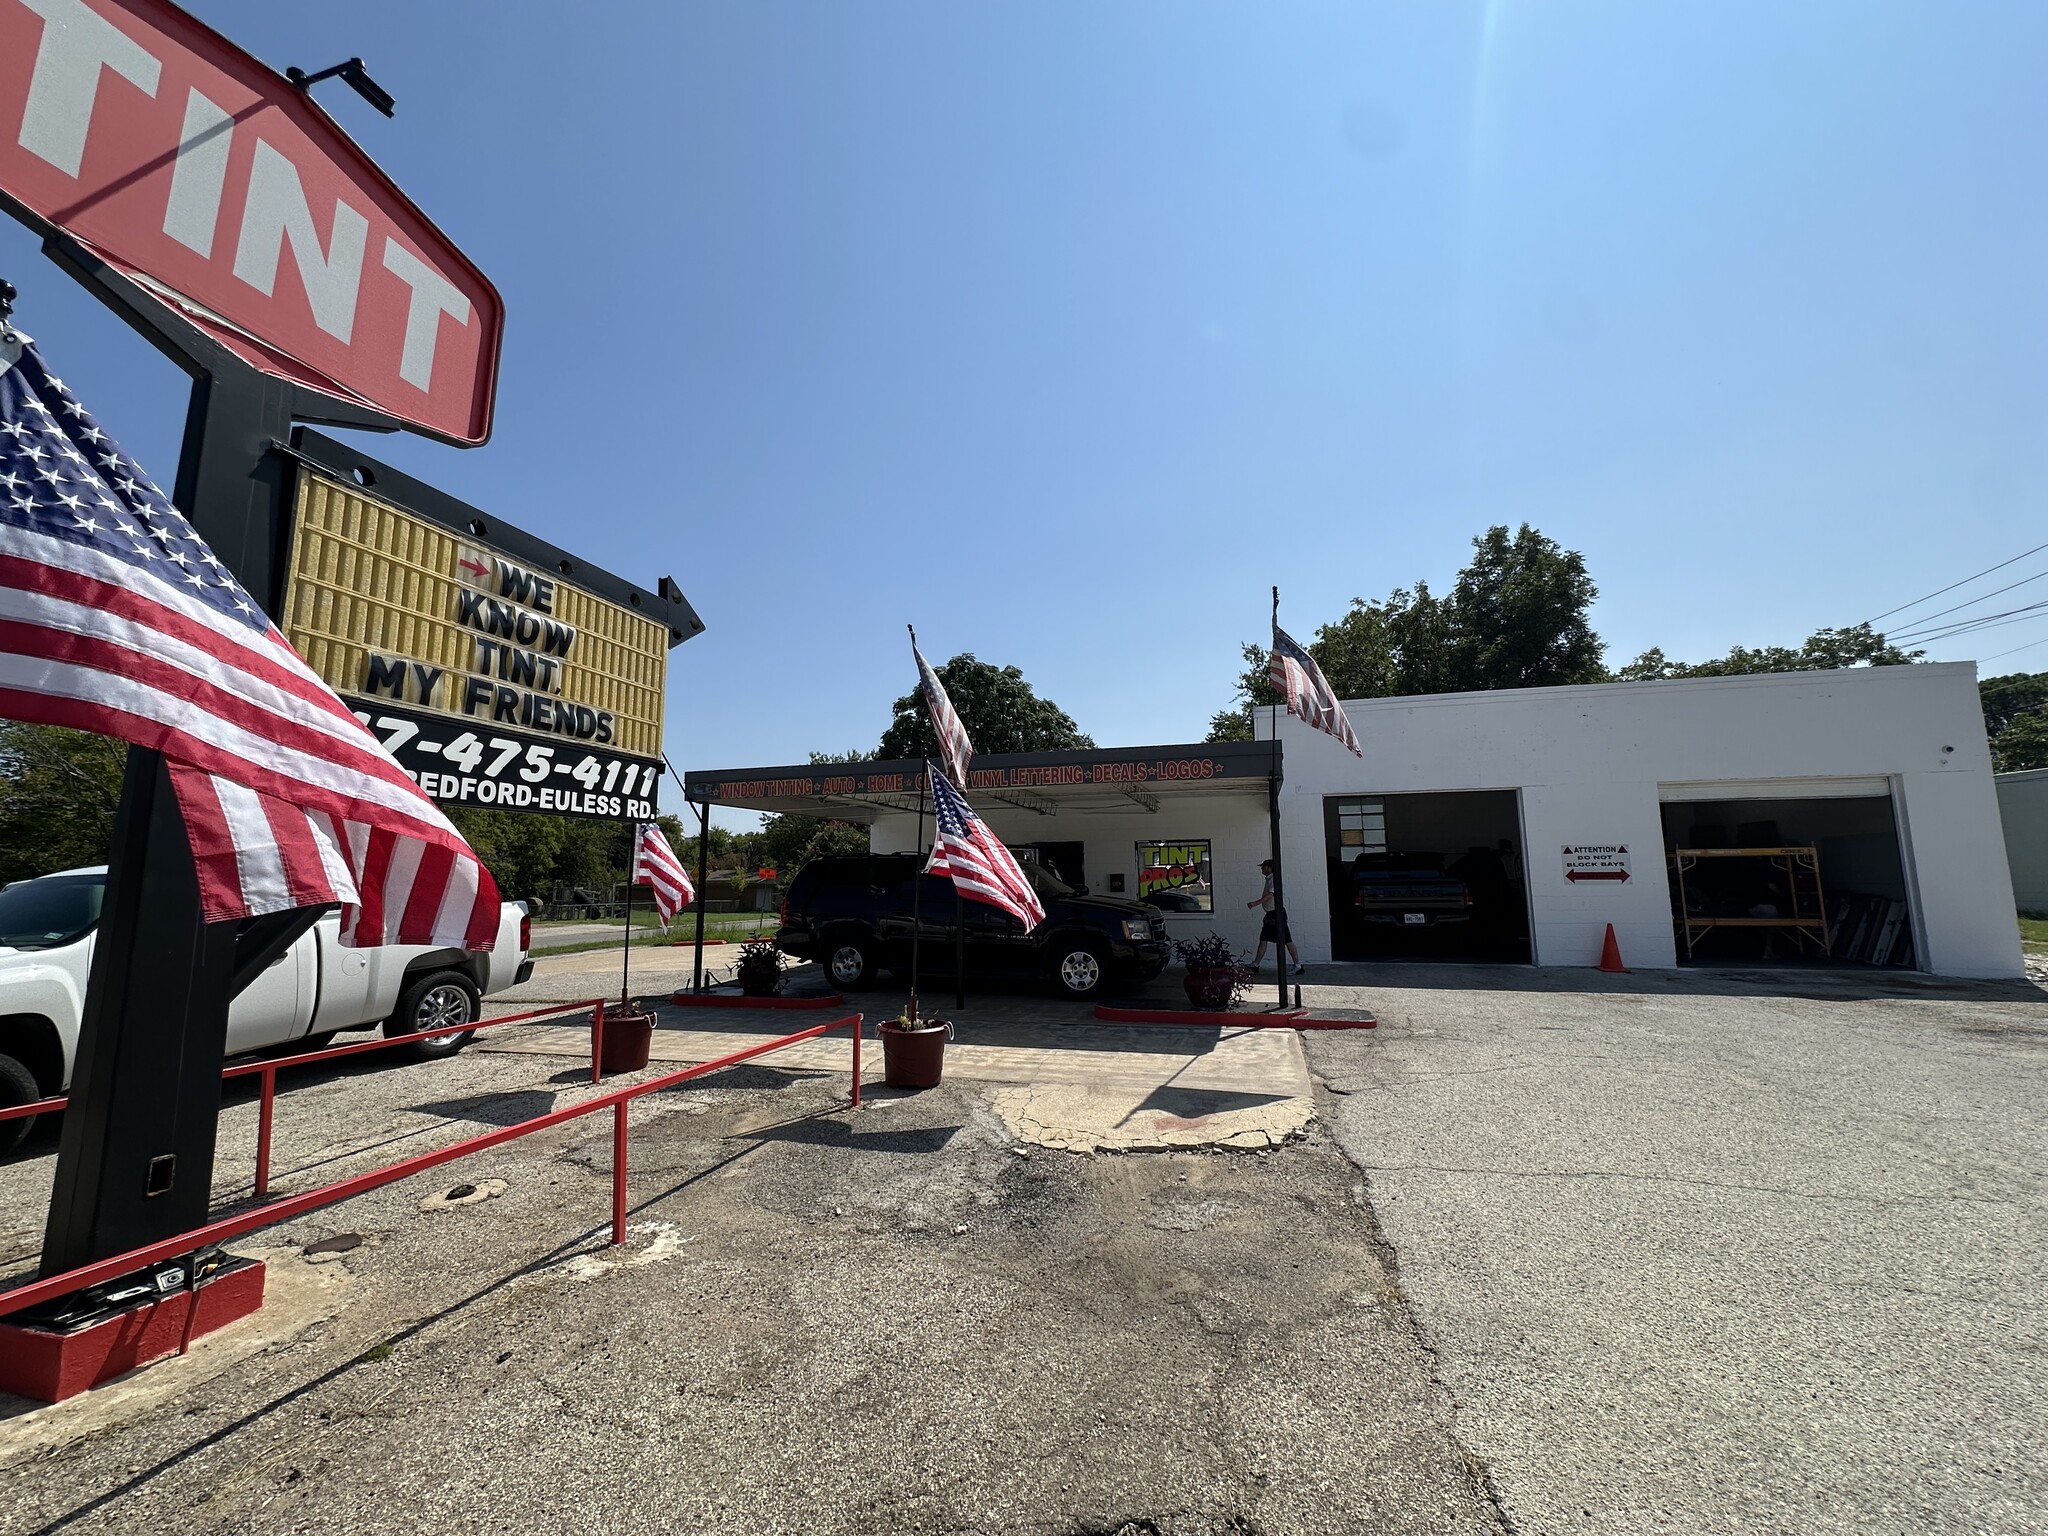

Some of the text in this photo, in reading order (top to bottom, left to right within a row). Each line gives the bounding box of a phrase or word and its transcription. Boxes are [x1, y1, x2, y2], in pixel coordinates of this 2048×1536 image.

[17, 0, 471, 394] TINT
[499, 560, 554, 615] WE
[460, 588, 575, 657] KNOW
[365, 655, 617, 746] MY FRIENDS.
[354, 711, 657, 798] 7-475-4111
[719, 781, 766, 798] WINDOW
[767, 778, 813, 796] TINTING
[822, 776, 855, 794] AUTO
[868, 773, 903, 792] HOME
[970, 768, 1008, 788] VINYL
[1010, 764, 1084, 786] LETTERING
[1092, 762, 1147, 783] DECALS
[1156, 759, 1213, 779] LOGOS
[626, 799, 656, 820] RD.
[1141, 845, 1207, 866] TINT
[1574, 846, 1616, 854] ATTENTION
[1139, 866, 1199, 899] PROS
